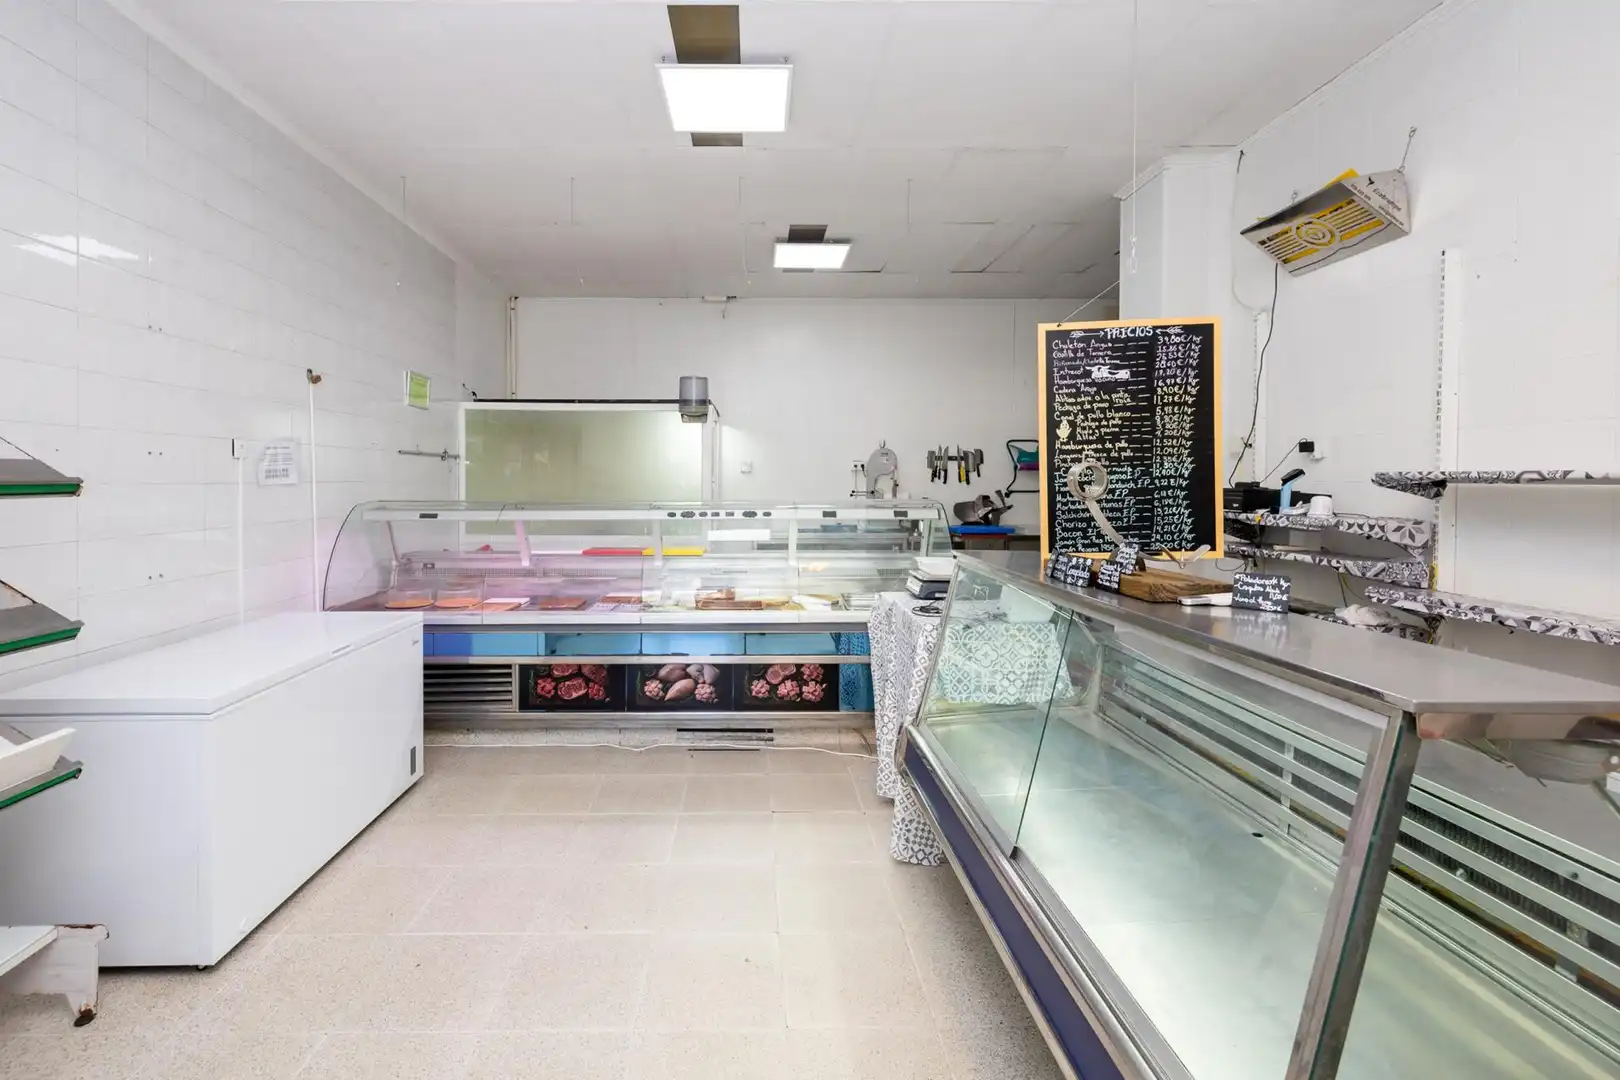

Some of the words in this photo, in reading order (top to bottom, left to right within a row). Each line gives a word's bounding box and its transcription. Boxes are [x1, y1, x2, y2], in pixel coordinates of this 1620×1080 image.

[1076, 350, 1085, 358] de
[1083, 401, 1092, 410] de
[1106, 408, 1131, 418] blanco
[1104, 440, 1113, 449] de
[1109, 448, 1119, 457] de
[1054, 519, 1087, 529] Chorizo
[1055, 528, 1084, 538] Bacon
